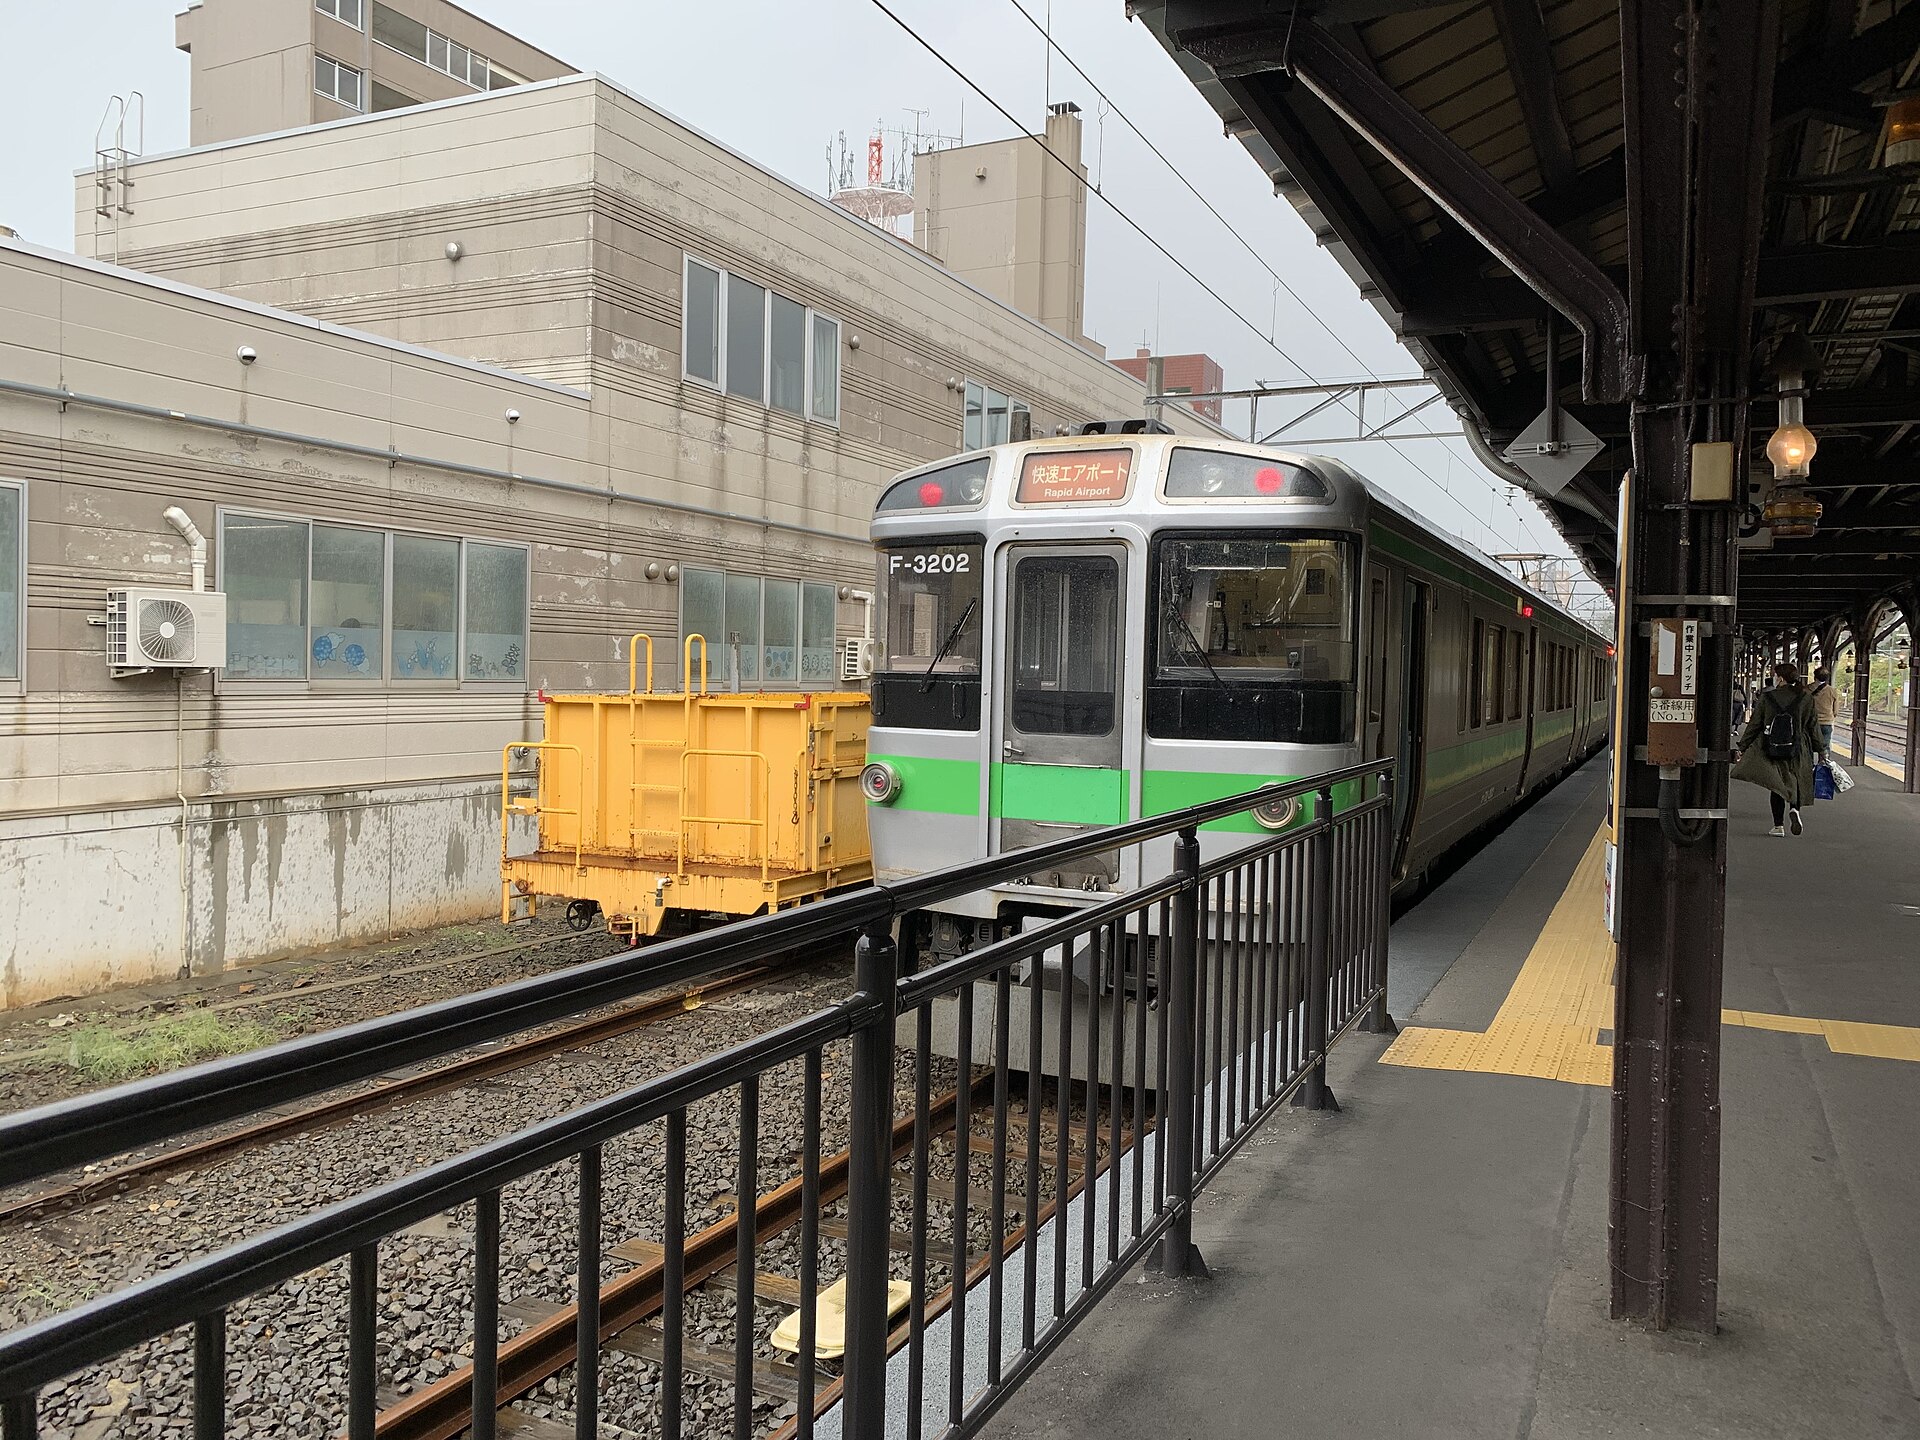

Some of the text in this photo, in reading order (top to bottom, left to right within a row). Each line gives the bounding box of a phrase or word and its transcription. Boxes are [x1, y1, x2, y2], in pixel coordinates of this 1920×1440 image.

[1032, 462, 1127, 484] 快速エアポート
[1044, 487, 1111, 498] Rapid Airport
[890, 553, 970, 574] F-3202
[1684, 625, 1695, 690] 作業中スイッチ
[1651, 700, 1694, 711] 5番線用
[1651, 711, 1693, 721] (No.1)
